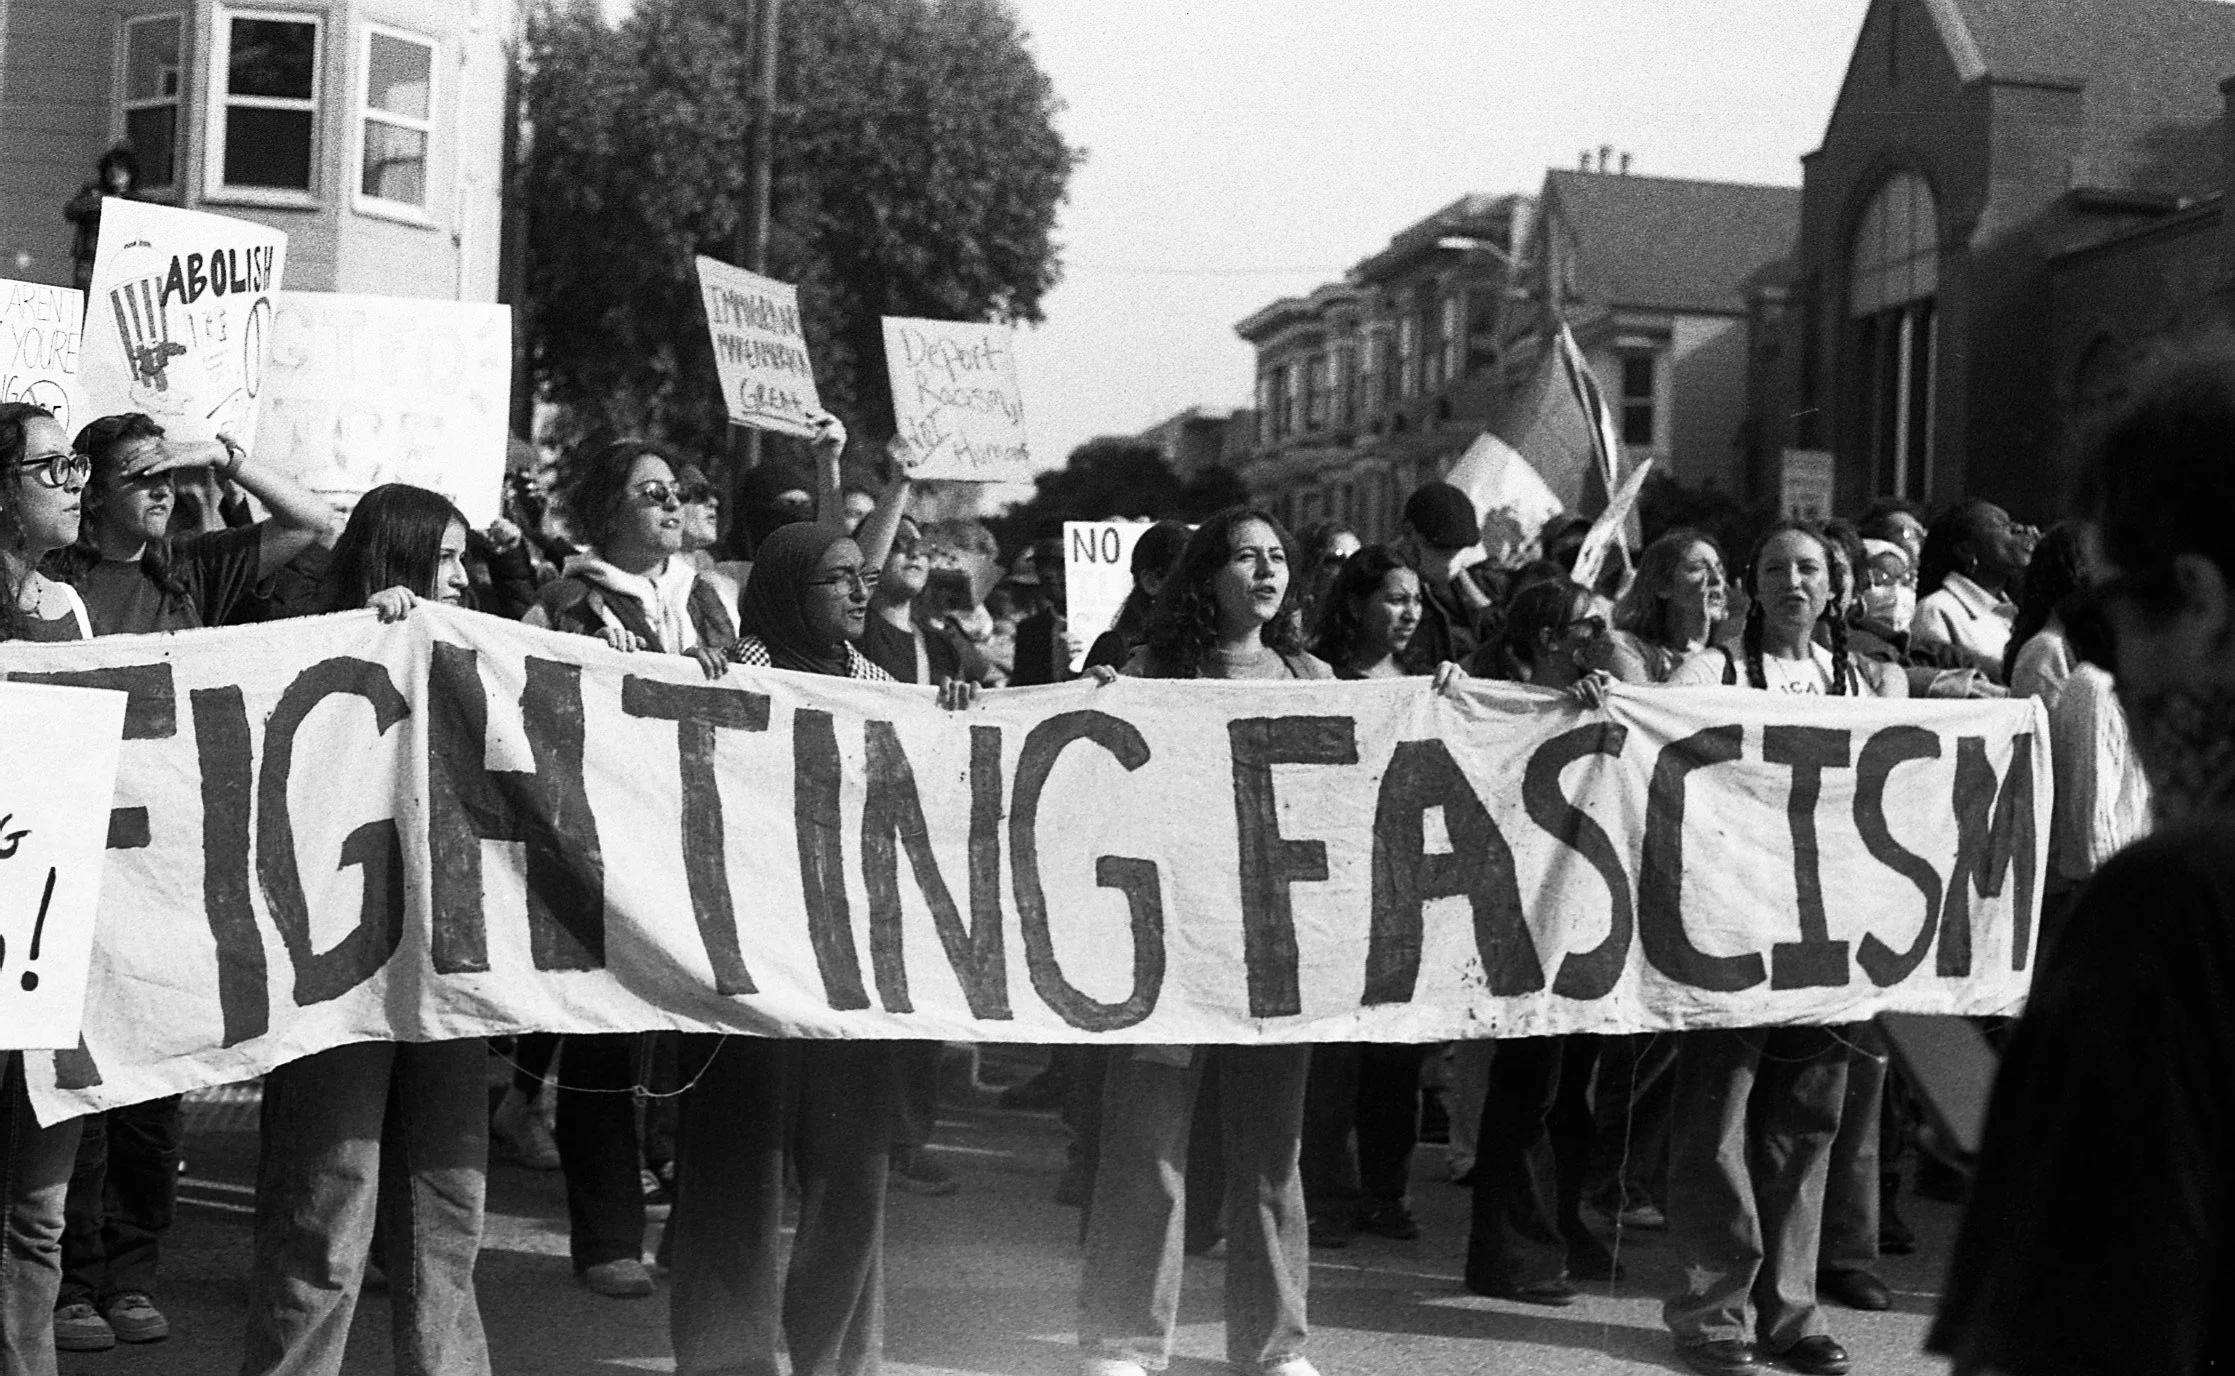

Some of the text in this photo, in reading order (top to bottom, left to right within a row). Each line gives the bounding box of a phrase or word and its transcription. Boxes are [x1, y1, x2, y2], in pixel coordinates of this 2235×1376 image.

[164, 245, 274, 306] ABOLISH
[1073, 527, 1120, 564] NO
[1227, 714, 2034, 1018] FASCISM
